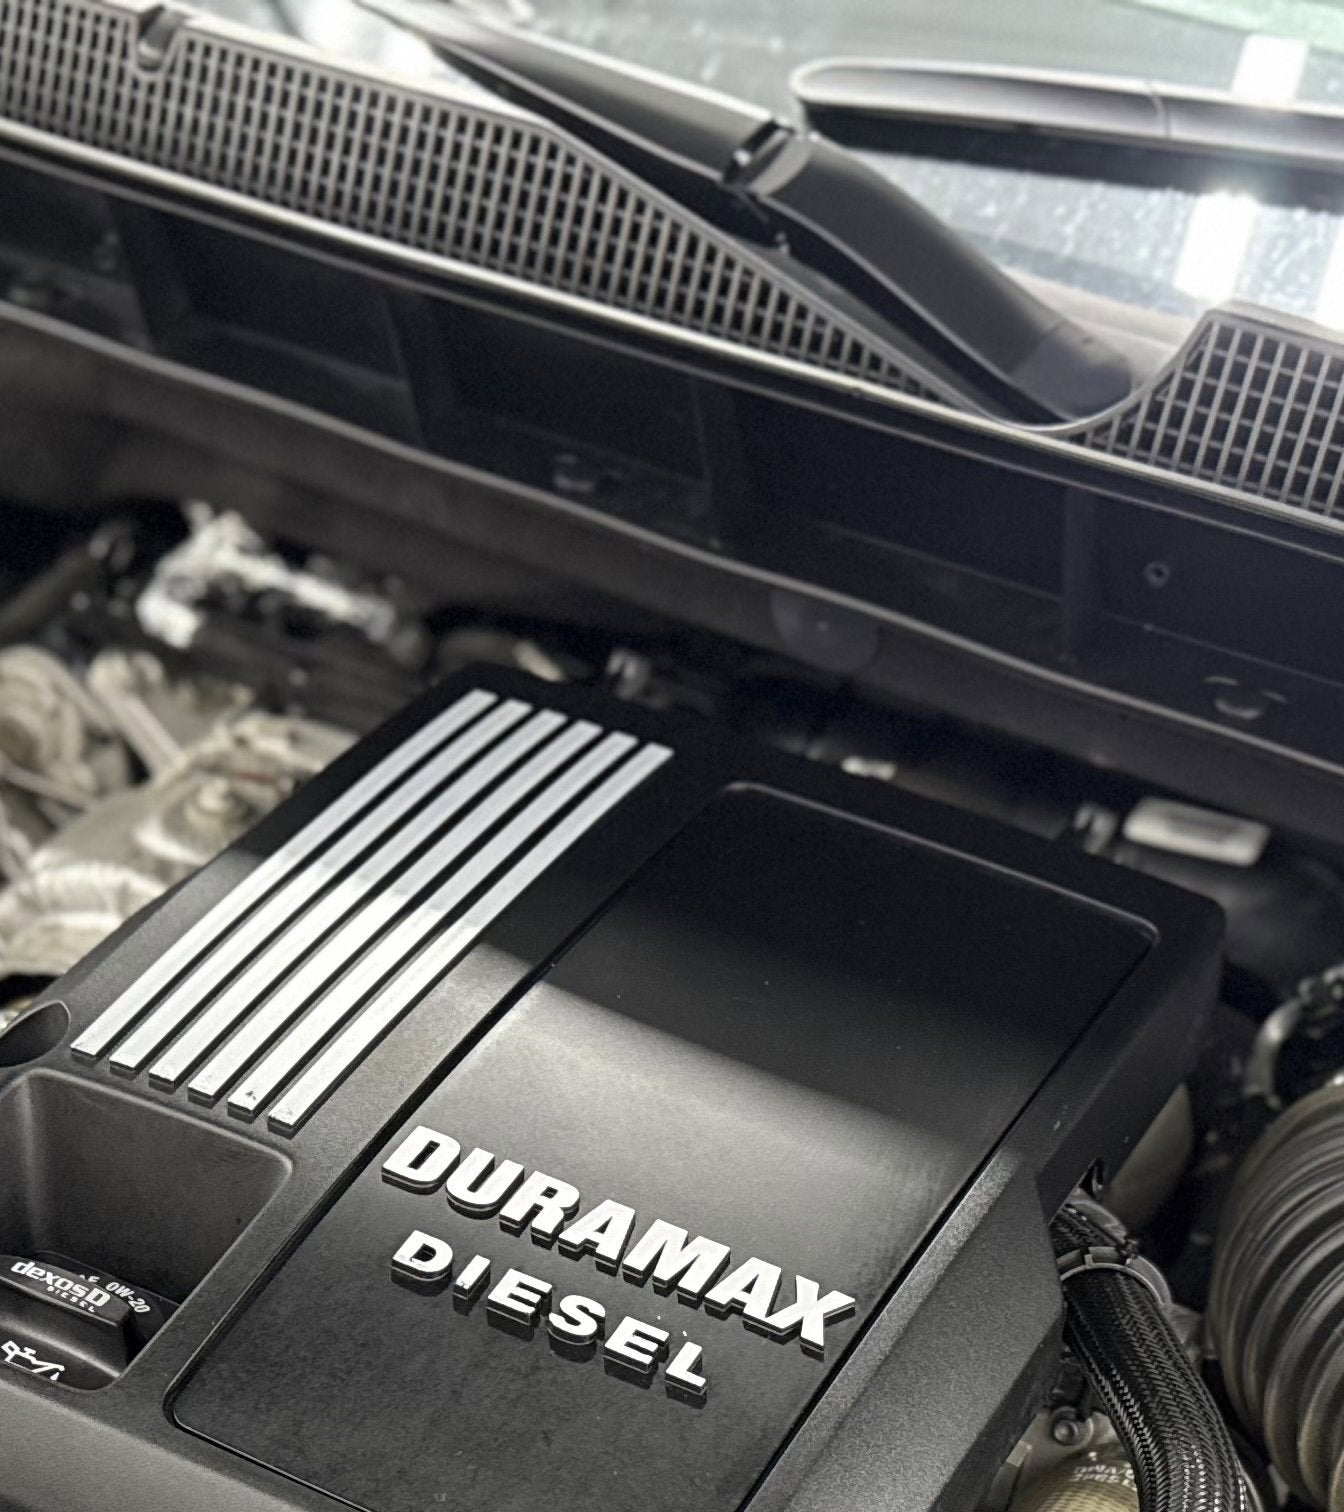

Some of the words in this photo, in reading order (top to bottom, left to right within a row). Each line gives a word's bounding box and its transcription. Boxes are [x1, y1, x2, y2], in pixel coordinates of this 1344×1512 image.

[381, 1125, 856, 1356] DURAMAX
[46, 1285, 95, 1313] DIESEL
[106, 1281, 151, 1313] 0W-20
[391, 1229, 709, 1396] DIESEL
